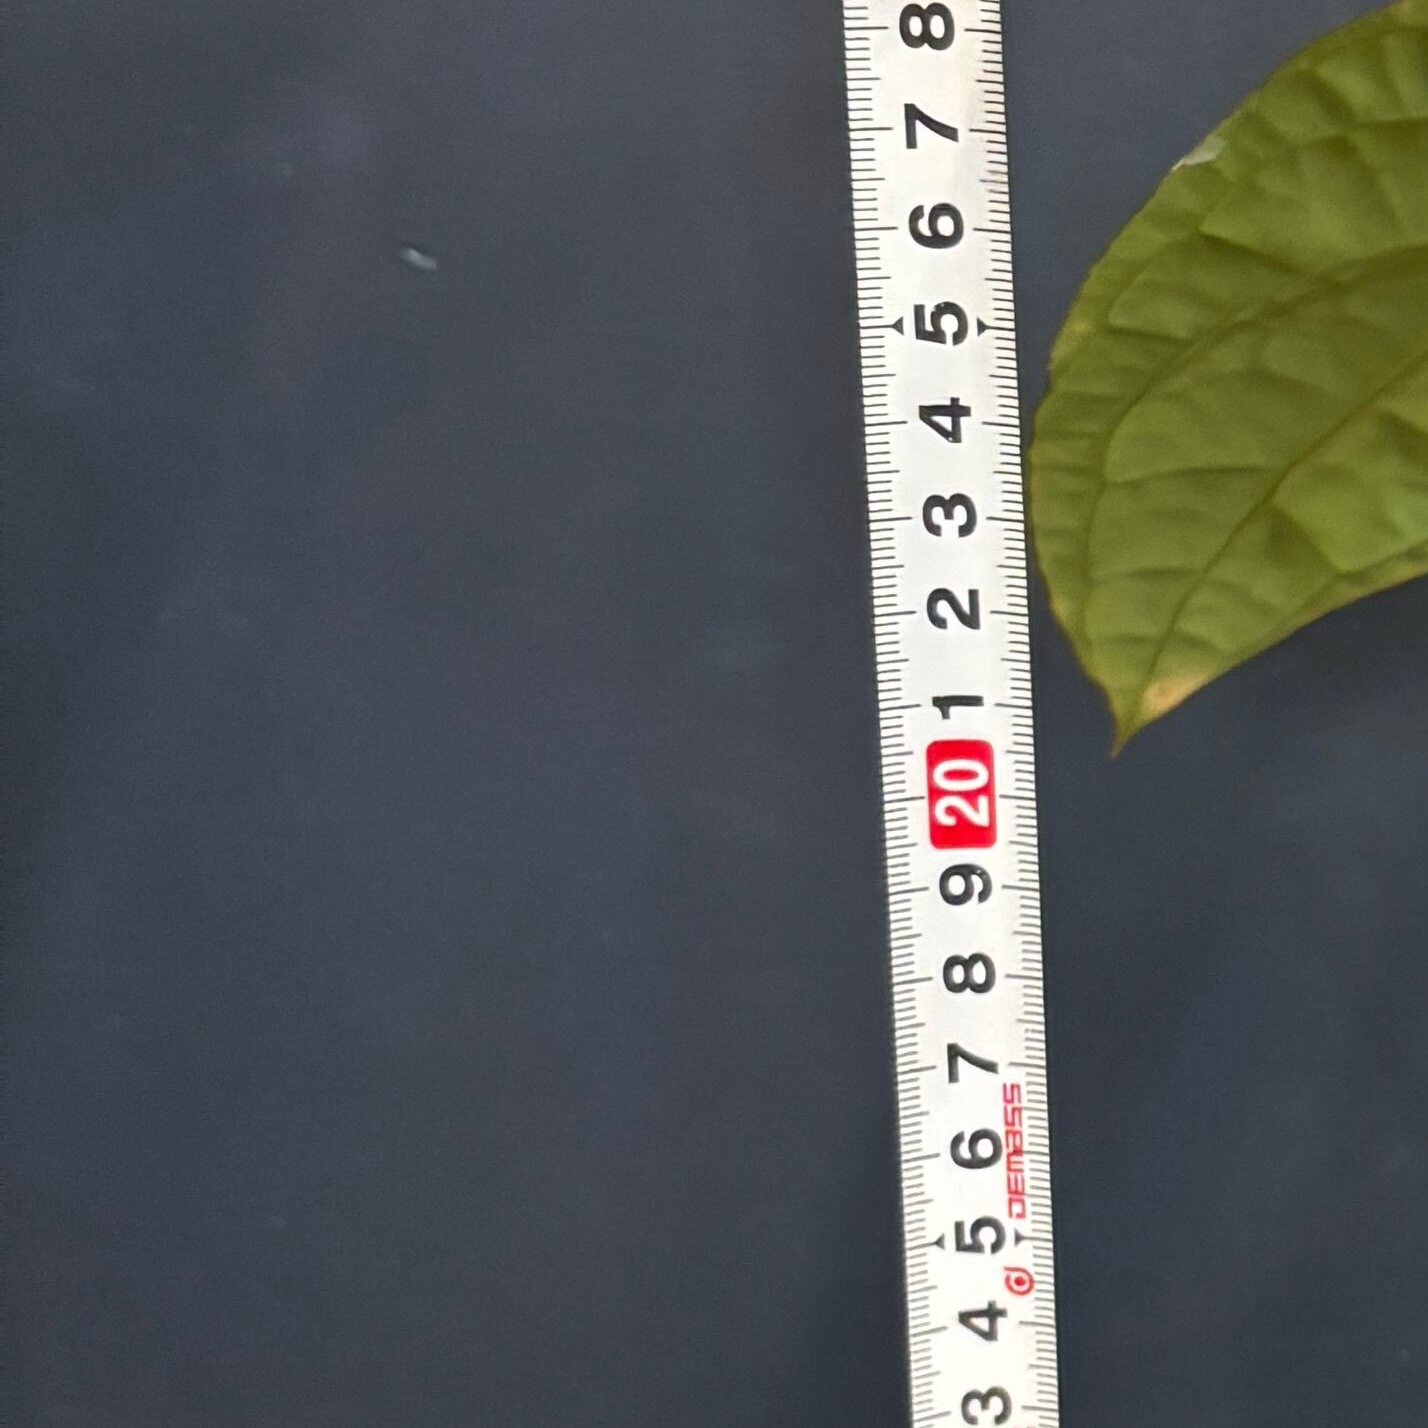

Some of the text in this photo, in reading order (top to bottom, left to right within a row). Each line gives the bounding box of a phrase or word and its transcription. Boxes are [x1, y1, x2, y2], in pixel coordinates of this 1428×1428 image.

[899, 2, 955, 51] 8
[904, 103, 959, 149] 7
[908, 202, 964, 250] 6
[913, 301, 968, 346] 5
[918, 397, 972, 444] 4
[922, 492, 977, 538] 3
[926, 587, 981, 630] 2
[932, 695, 984, 720] 1
[933, 758, 989, 828] 20
[939, 863, 993, 906] 9
[942, 952, 996, 994] 8
[946, 1042, 999, 1084] 7
[950, 1128, 1002, 1170] 6
[954, 1215, 1006, 1255] 5
[958, 1300, 1007, 1342] 4
[961, 1386, 1012, 1426] 3
